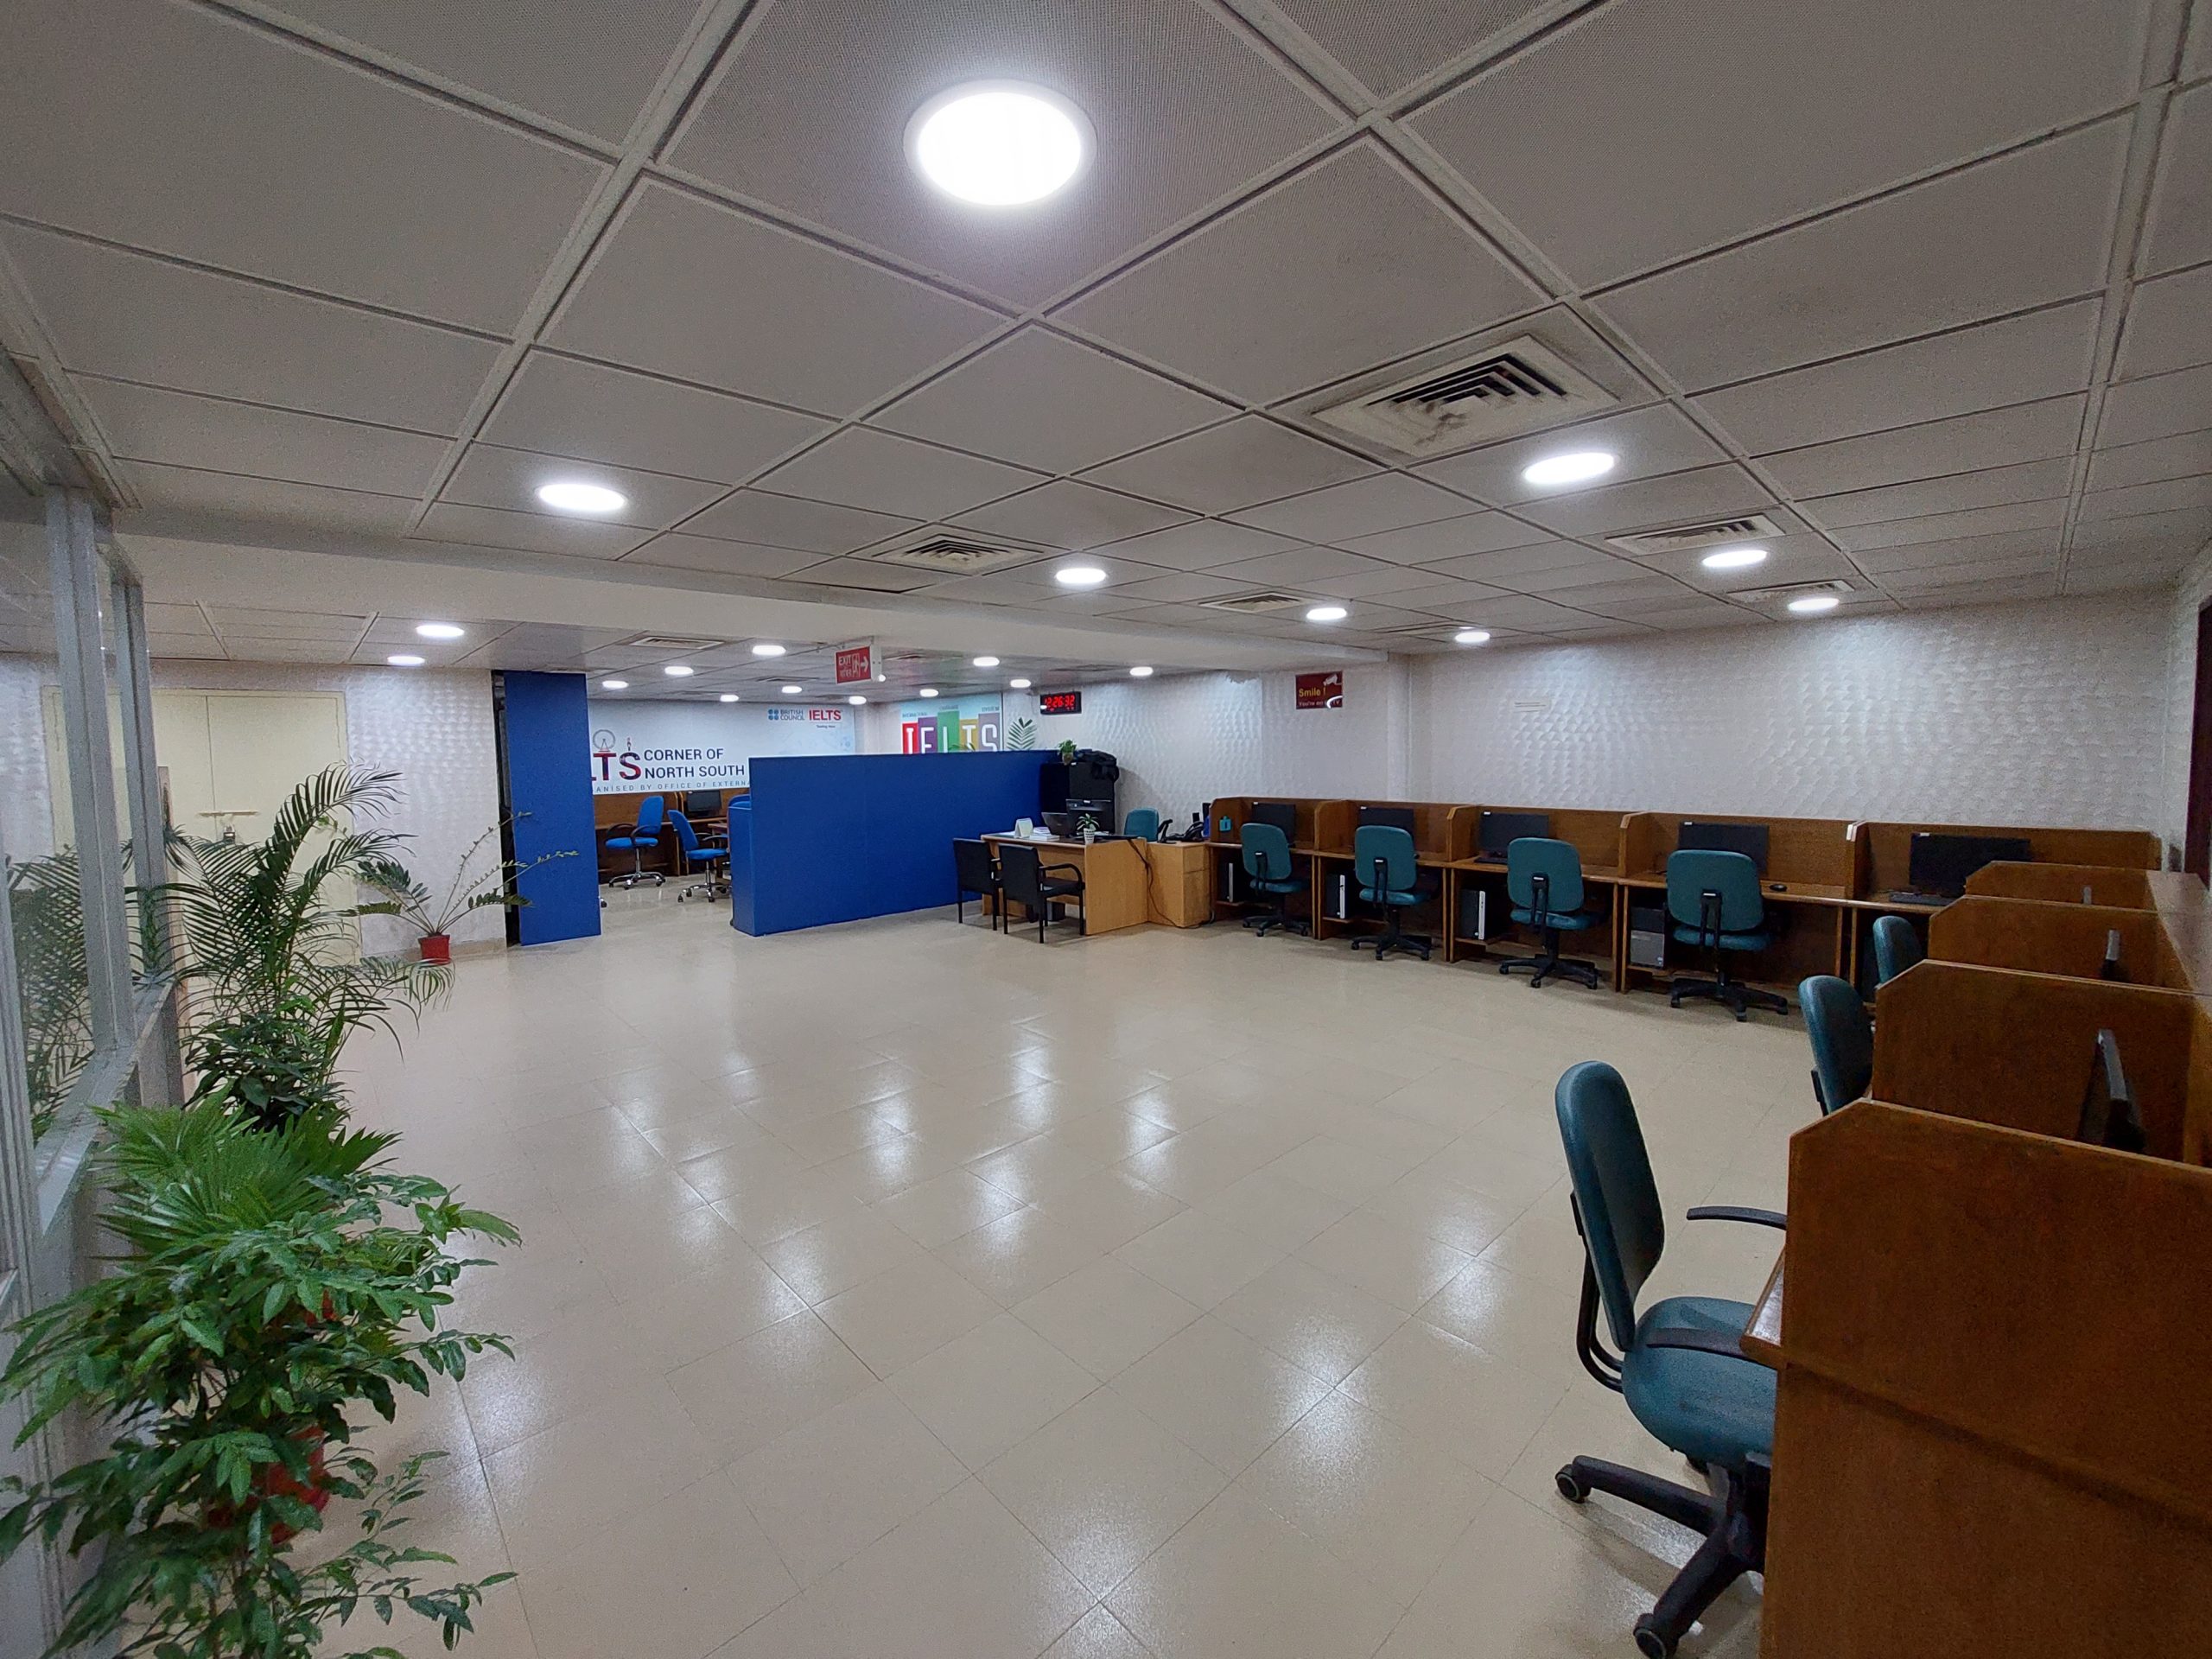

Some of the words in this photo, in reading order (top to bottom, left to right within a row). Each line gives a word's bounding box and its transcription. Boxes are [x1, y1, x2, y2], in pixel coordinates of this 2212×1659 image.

[839, 655, 852, 665] EXIT
[1299, 688, 1321, 697] Smile
[809, 709, 842, 721] IELTS
[644, 749, 702, 760] CORNER
[706, 748, 723, 760] OF
[590, 752, 641, 781] TS
[645, 766, 695, 779] NORTH
[699, 765, 744, 777] SOUTH
